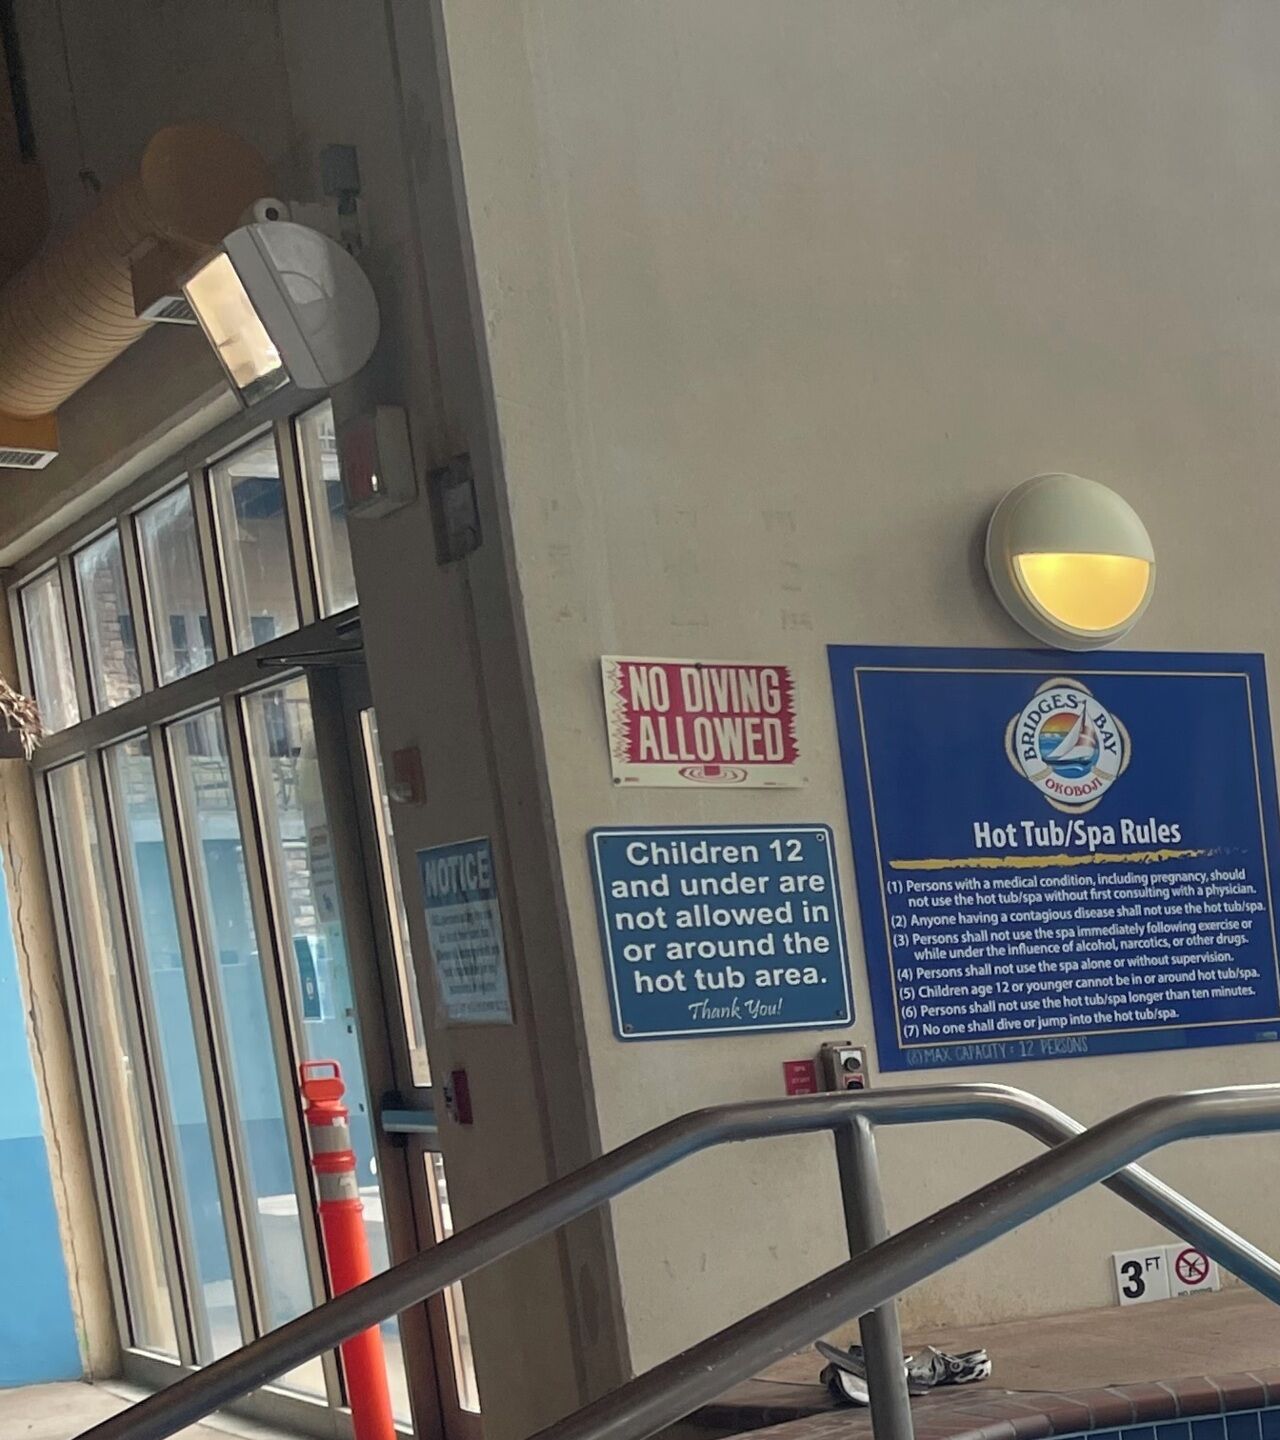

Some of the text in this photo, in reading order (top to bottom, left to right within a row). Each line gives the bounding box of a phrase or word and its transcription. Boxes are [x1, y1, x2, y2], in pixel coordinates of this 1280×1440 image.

[628, 666, 781, 714] NO DIVING
[639, 717, 784, 761] ALLOWED
[1022, 694, 1116, 761] BRIDGES BAY
[1045, 778, 1102, 796] OKOBOJI
[974, 818, 1181, 851] Hot Tub/Spa Rules
[627, 840, 803, 865] Children 12
[425, 851, 490, 897] NOTICE
[612, 872, 824, 898] and under are
[887, 869, 1245, 894] (1) Persons with a medical condition, including pregnancy, should
[908, 896, 928, 907] not
[931, 896, 951, 906] use
[954, 893, 973, 905] the
[976, 892, 996, 904] hot
[999, 891, 1042, 905] tub/spa
[1045, 889, 1088, 902] without
[1091, 889, 1111, 899] first
[1114, 887, 1170, 899] consulting
[1172, 885, 1195, 897] with
[1206, 885, 1256, 898] physician.
[616, 901, 829, 929] not allowed in
[891, 901, 1266, 928] (2) Anyone having a contagious disease shall not use the hot tub/spa.
[624, 932, 829, 961] or around the
[893, 920, 1252, 947] (3) Persons shall not use the spa immediately following exercise or
[914, 933, 1249, 961] while under the influence of alcohol, narcotics, or other drugs.
[635, 967, 827, 992] hot tub area.
[898, 951, 1234, 982] (4) Persons shall not use the spa alone or without supervision.
[900, 968, 1260, 1000] (5) Children age 12 or younger cannot be in or around hot tub/spa.
[688, 997, 783, 1020] Thank You!
[902, 985, 1255, 1019] (6) Persons shall not use the hot tub/spa longer than ten minutes.
[904, 1009, 1179, 1038] (7) No one shall dive or jump into the hot tub/spa.
[924, 1048, 950, 1062] MAX
[1020, 1041, 1033, 1057] 12
[1040, 1037, 1088, 1054] PERSONS
[1121, 1257, 1160, 1298] 3 FT
